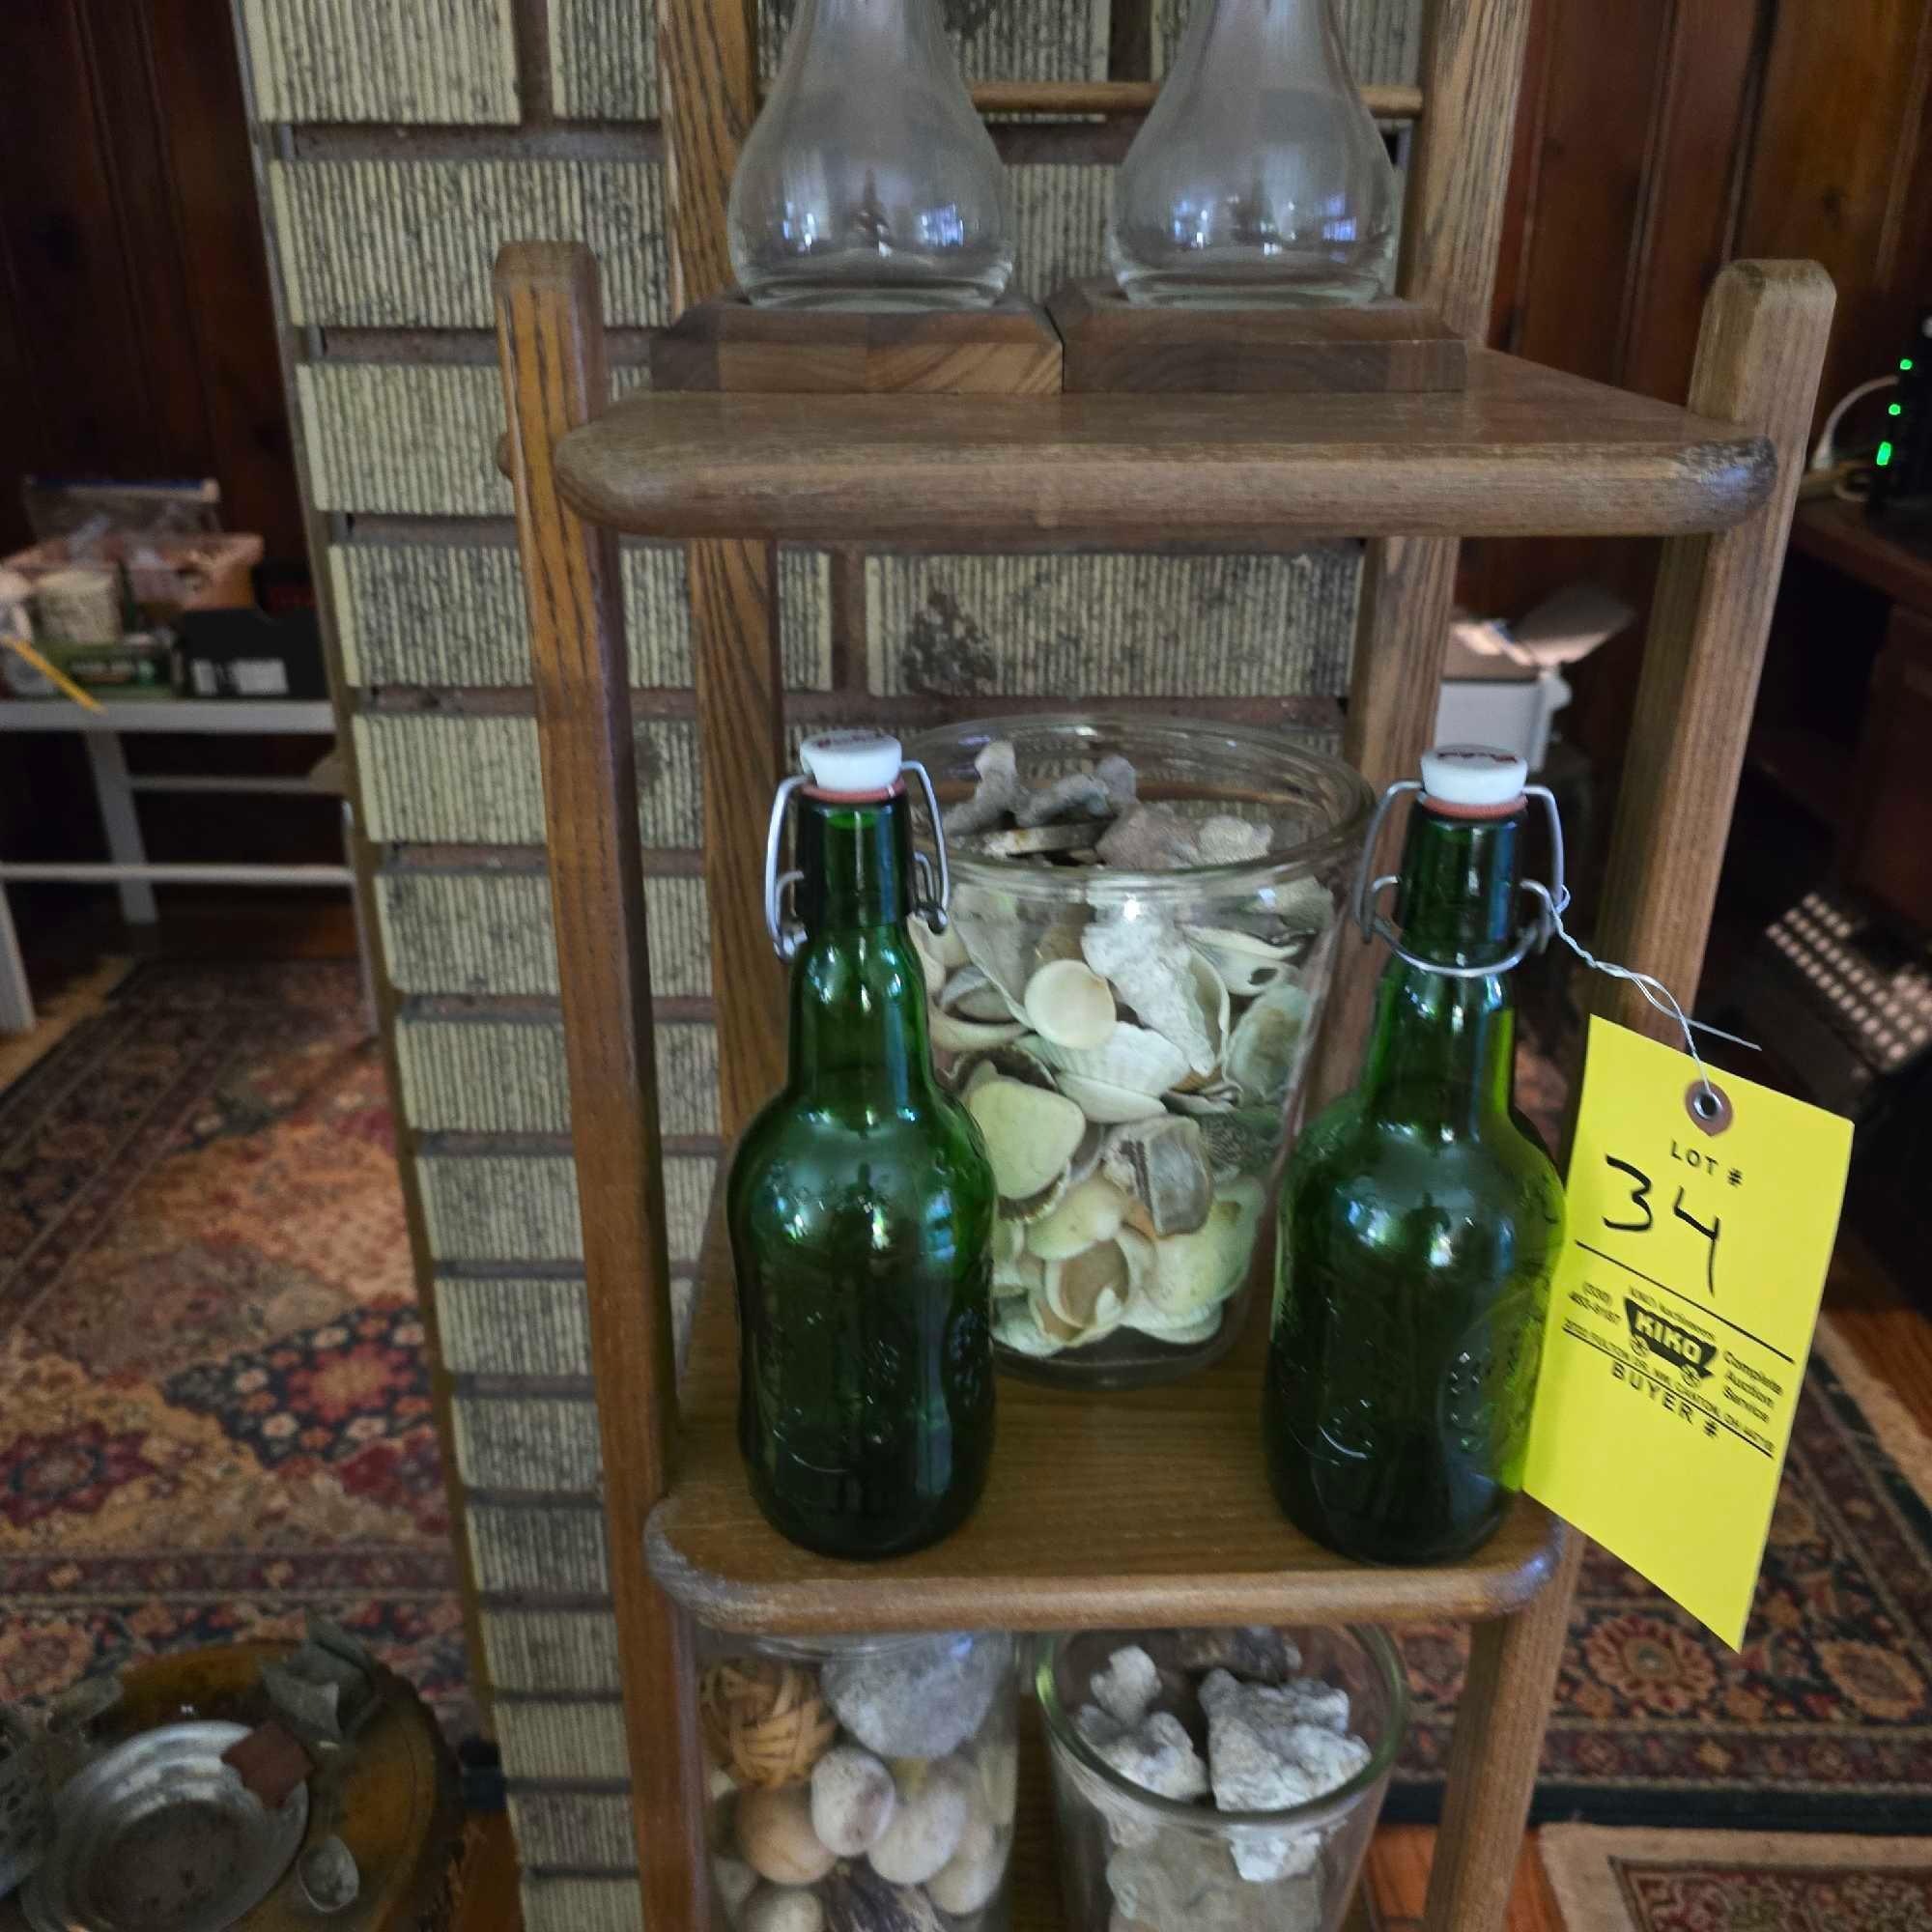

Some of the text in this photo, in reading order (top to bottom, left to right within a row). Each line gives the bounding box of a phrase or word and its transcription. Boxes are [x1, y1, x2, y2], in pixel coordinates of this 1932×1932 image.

[1670, 1140, 1744, 1187] LOT #
[1602, 1154, 1722, 1297] 34
[1634, 1309, 1703, 1364] KIKO
[1723, 1350, 1783, 1397] Complete
[1725, 1371, 1775, 1408] Auction
[1611, 1361, 1694, 1426] BUYER
[1702, 1419, 1719, 1439] #
[1722, 1385, 1771, 1424] Service
